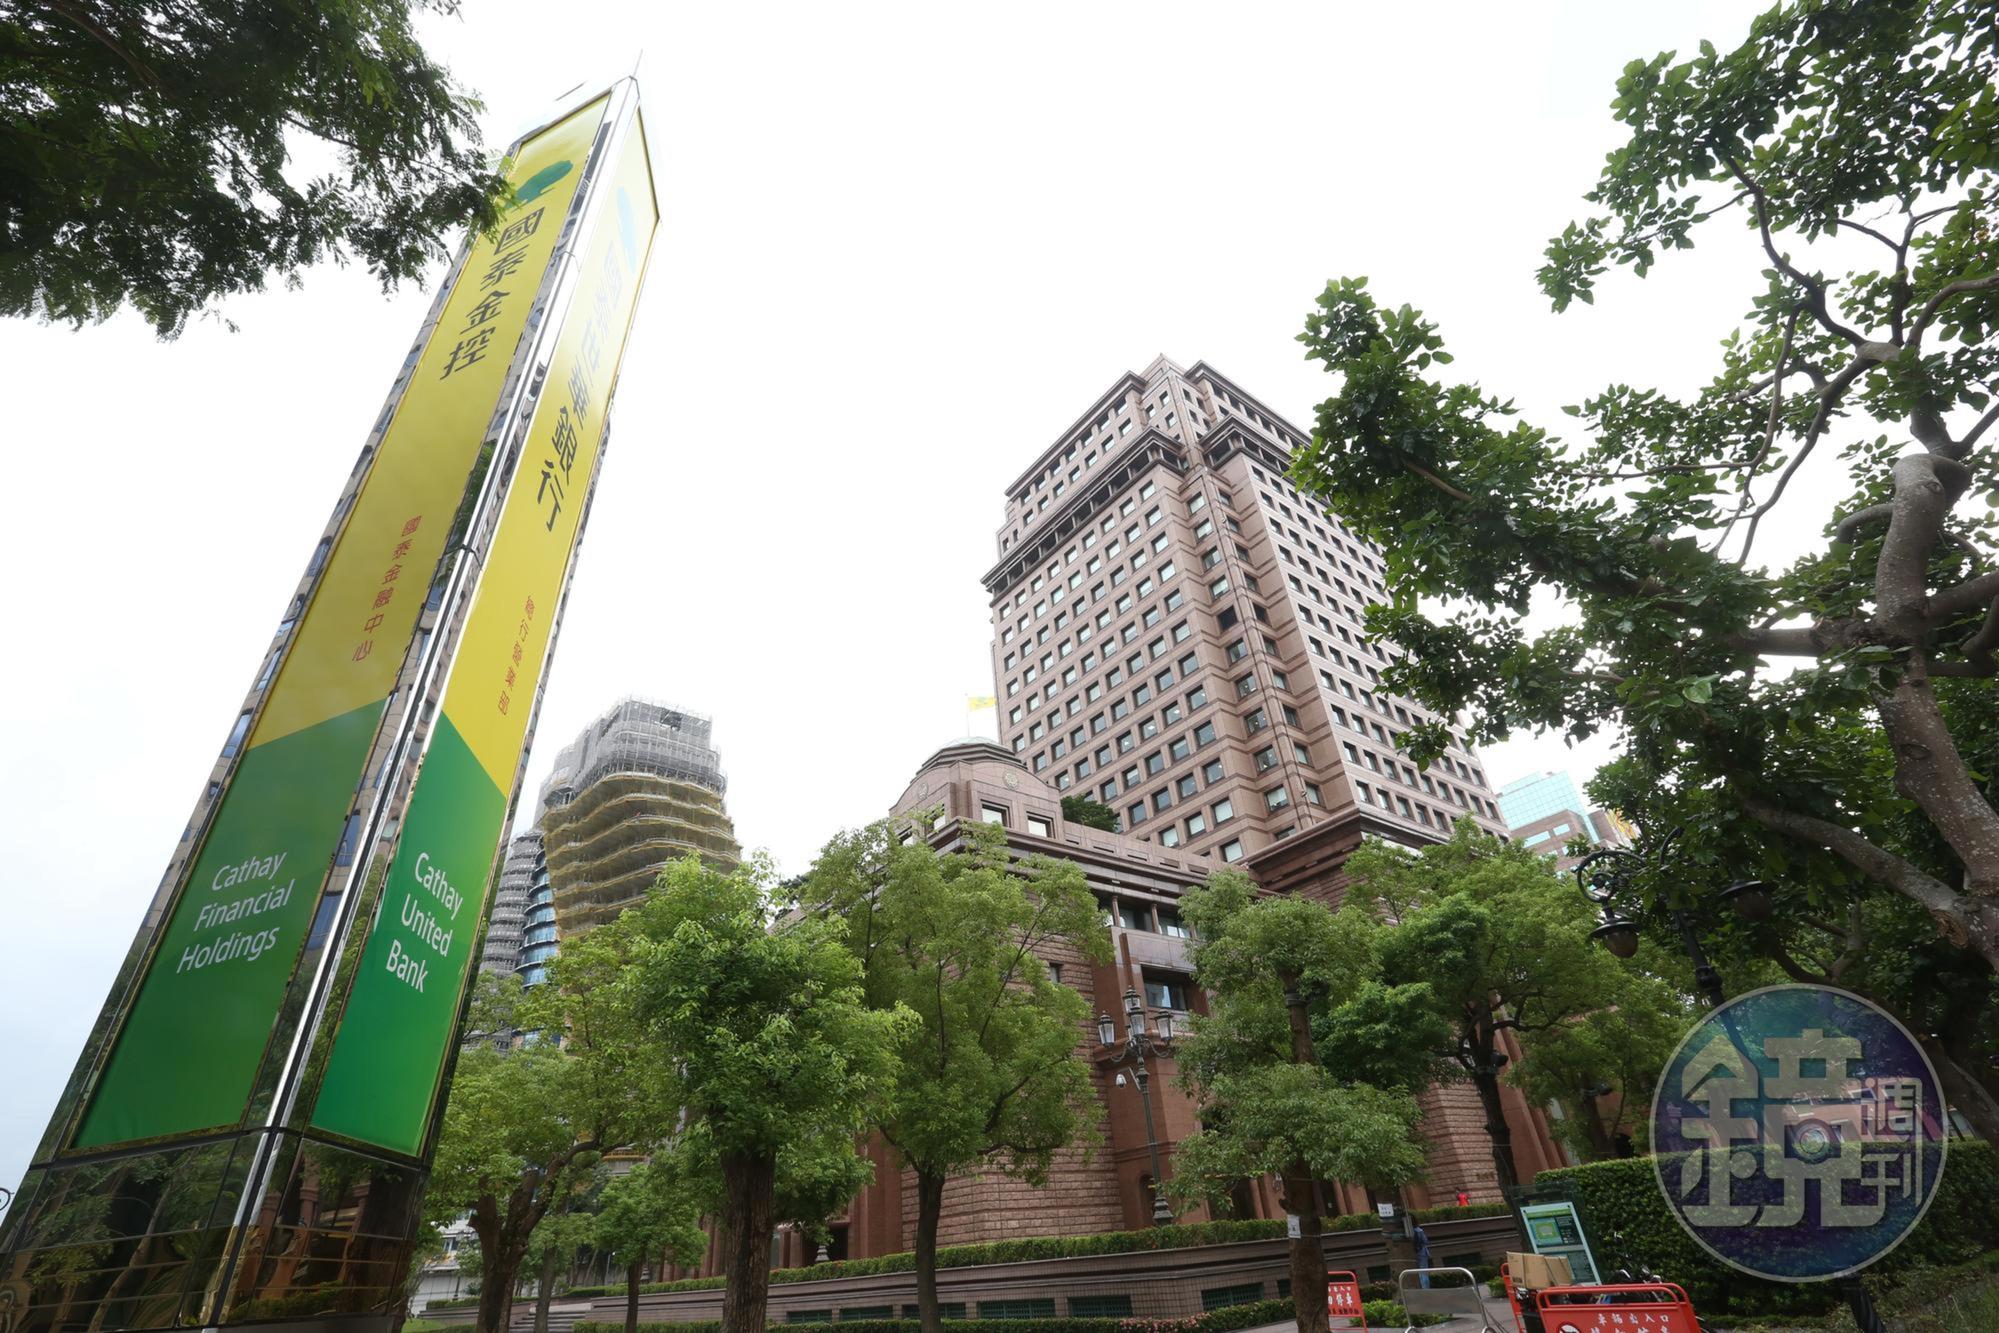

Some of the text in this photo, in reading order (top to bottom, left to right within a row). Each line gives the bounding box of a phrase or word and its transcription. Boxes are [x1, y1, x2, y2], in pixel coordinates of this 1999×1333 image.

[440, 206, 545, 380] 國泰金控
[537, 240, 623, 533] 國泰世華銀行
[352, 515, 422, 662] 國泰金融中心
[212, 852, 287, 891] Cathay
[415, 852, 463, 920] Cathay
[194, 878, 295, 931] Financial
[401, 894, 453, 957] United
[176, 926, 280, 974] Holdings
[386, 939, 428, 993] Bank
